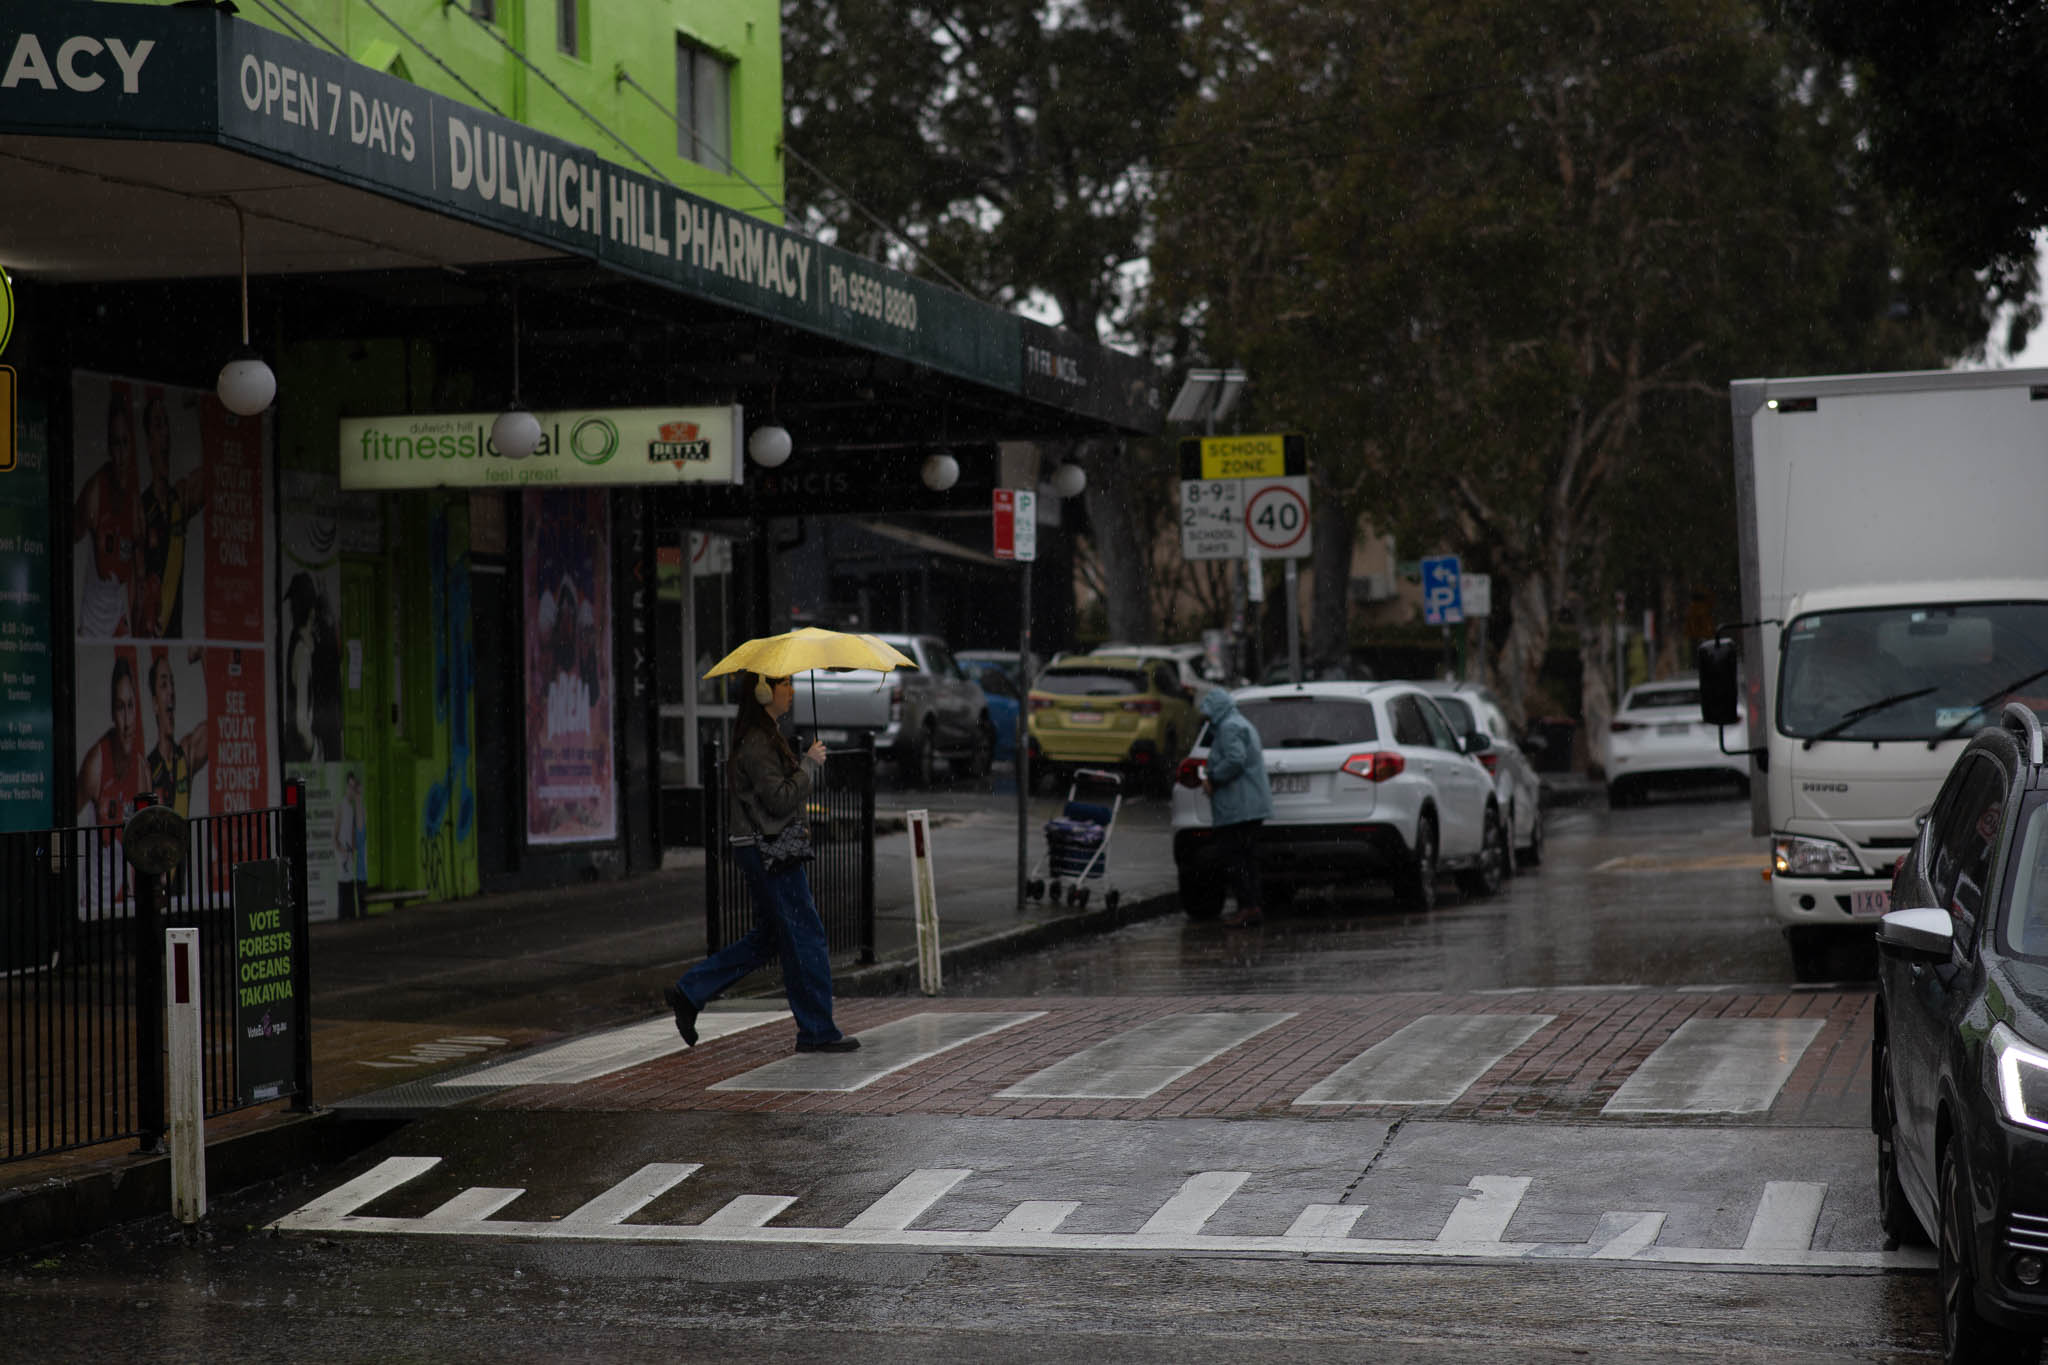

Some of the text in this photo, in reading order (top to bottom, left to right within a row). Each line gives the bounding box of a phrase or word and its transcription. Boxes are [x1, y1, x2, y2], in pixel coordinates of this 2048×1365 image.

[1, 33, 156, 94] ACY
[240, 53, 416, 163] OPEN 7 DAYS
[448, 115, 810, 302] DULWICH HILL PHARMACY
[828, 263, 848, 308] Ph
[410, 420, 474, 435] dulwich hill
[360, 423, 560, 461] fitnesslal
[1208, 441, 1278, 456] SCHOOL
[485, 466, 559, 484] feel great
[1221, 459, 1264, 473] ZONE
[1257, 503, 1299, 531] 40
[226, 690, 247, 713] SEE
[217, 715, 257, 739] YOU AT
[218, 741, 257, 765] NORTH
[215, 767, 261, 792] SYDNEY
[1802, 783, 1848, 793] HINO
[224, 792, 250, 814] OVAL
[248, 908, 281, 933] VOTE
[239, 931, 292, 959] FORESTS
[241, 956, 292, 984] OCEANS
[240, 979, 295, 1008] TAKAYNA
